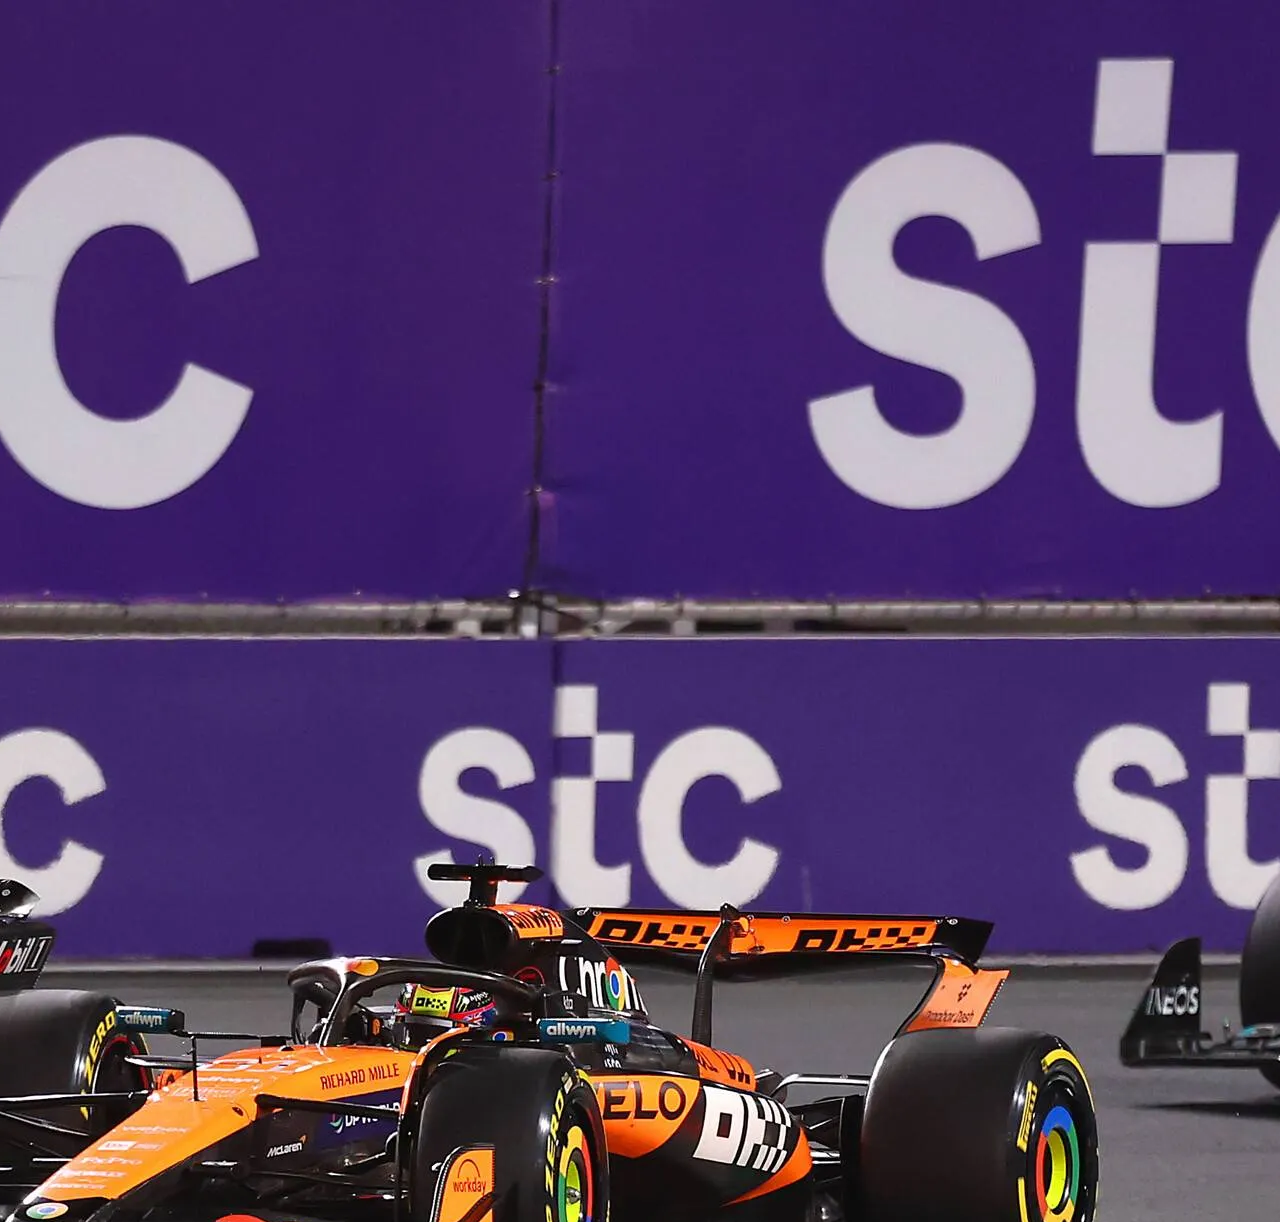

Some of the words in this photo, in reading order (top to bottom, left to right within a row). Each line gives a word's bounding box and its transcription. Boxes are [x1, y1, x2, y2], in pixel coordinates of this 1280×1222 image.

[413, 684, 782, 912] stc
[546, 1022, 597, 1037] allwyn
[320, 1068, 366, 1090] RICHARD
[368, 1062, 400, 1081] MILLE
[267, 1142, 303, 1158] McLaren
[545, 1088, 565, 1198] ZERO
[453, 1177, 487, 1198] workday
